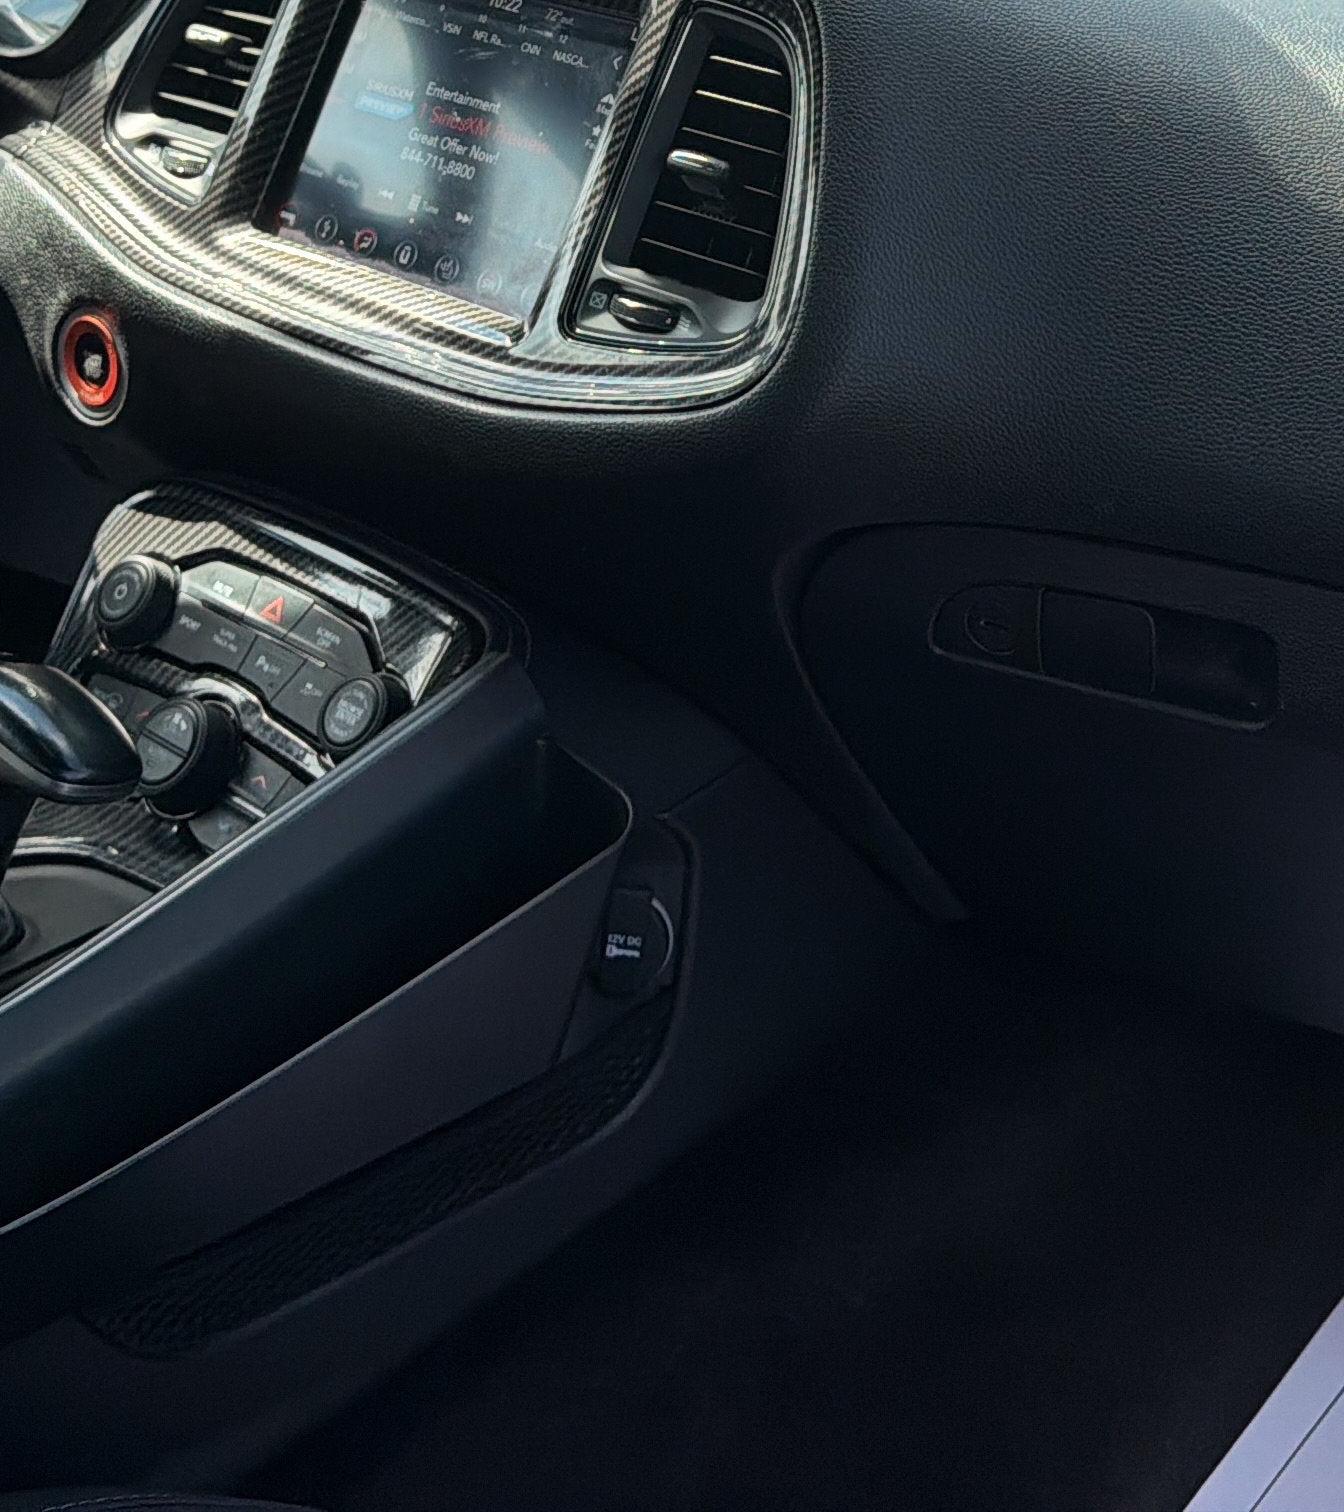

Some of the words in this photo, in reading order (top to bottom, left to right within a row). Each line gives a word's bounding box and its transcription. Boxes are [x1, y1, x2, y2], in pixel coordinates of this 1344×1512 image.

[521, 41, 542, 56] CNN
[425, 81, 502, 115] Entertainment
[430, 105, 493, 138] SiriusXM
[408, 127, 440, 147] Great
[440, 136, 468, 156] Offer
[468, 143, 501, 166] Now!
